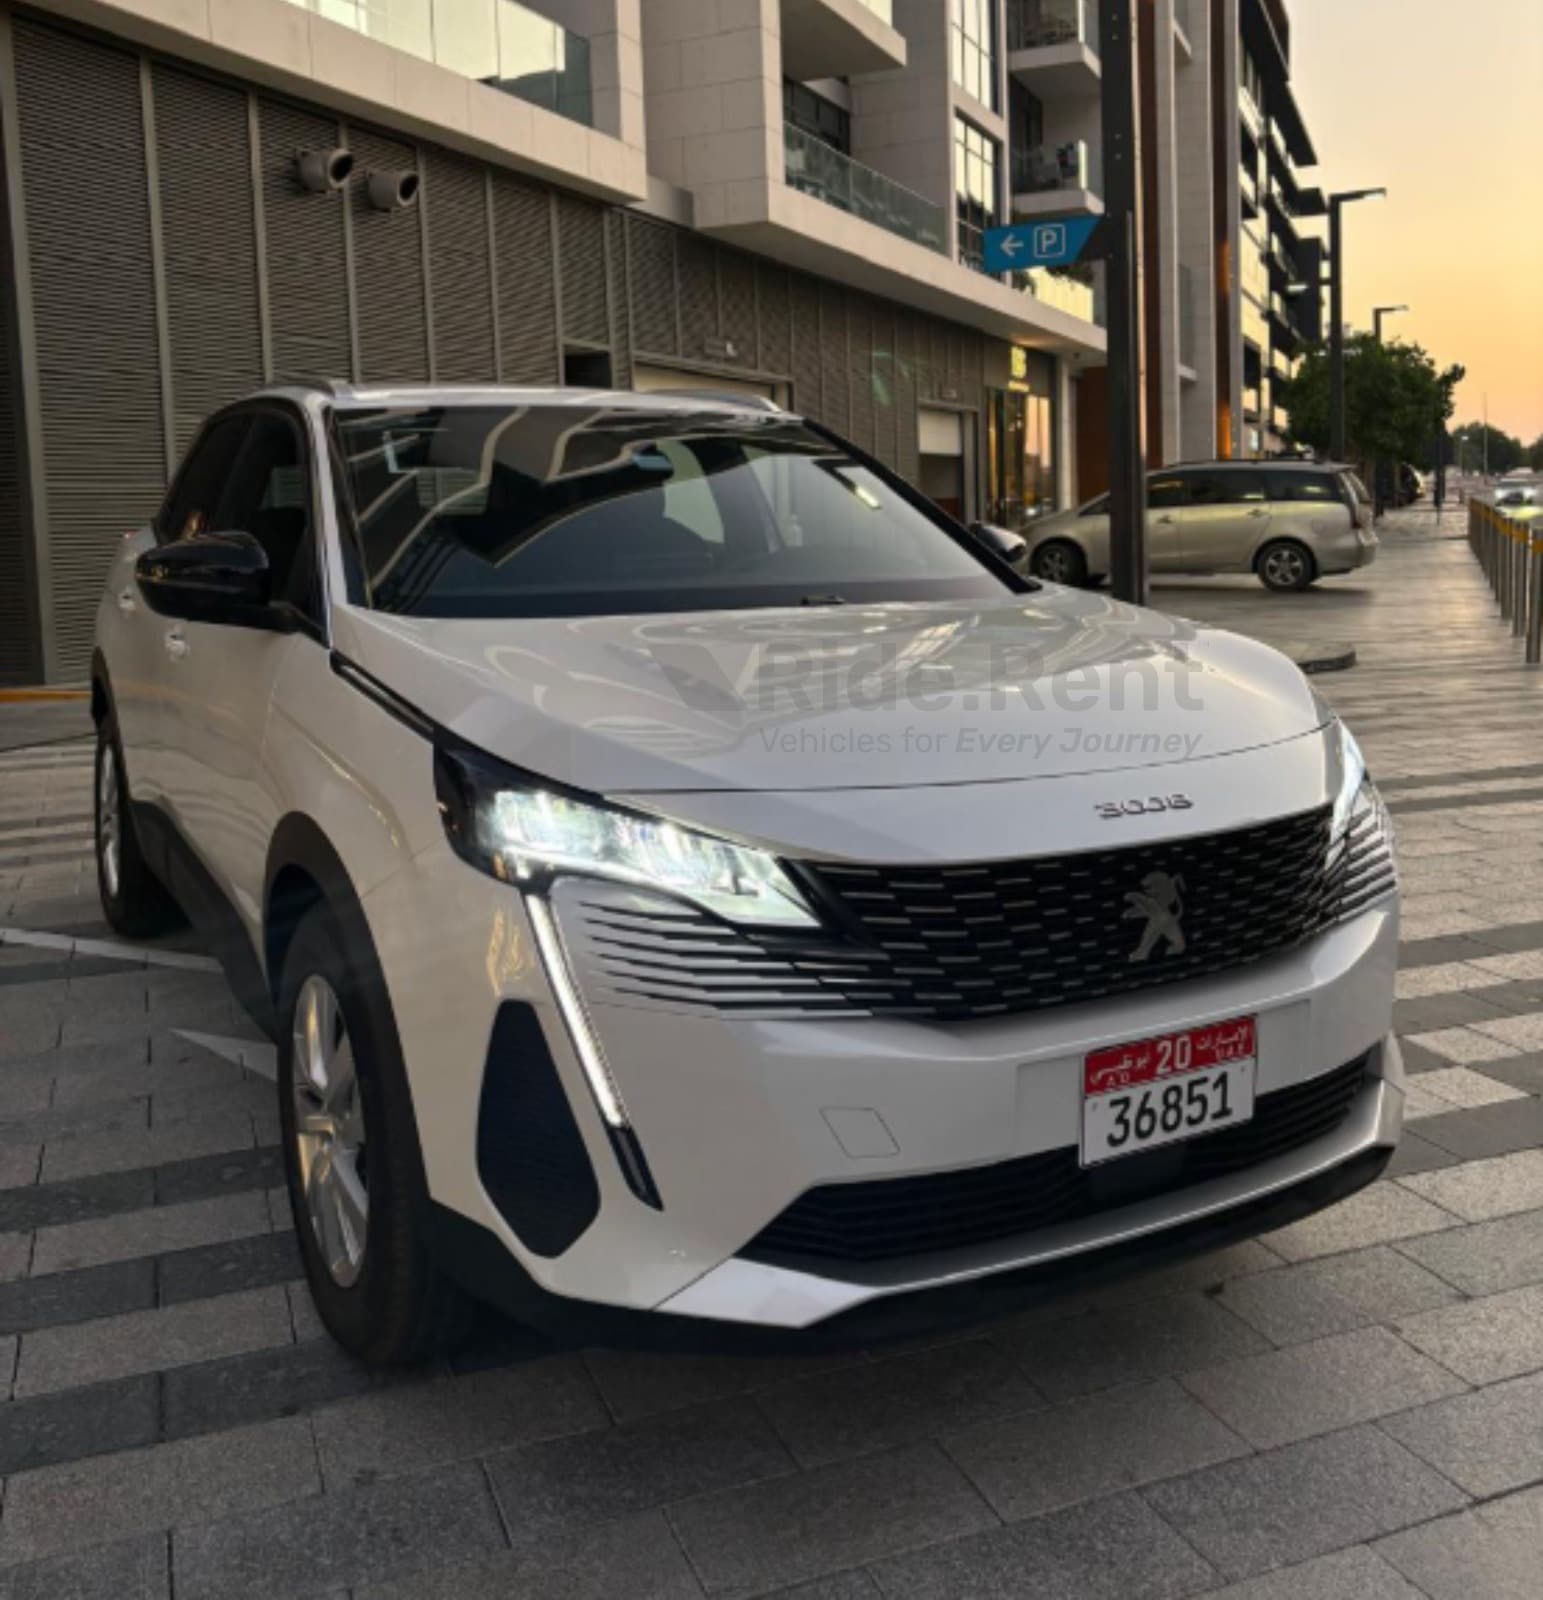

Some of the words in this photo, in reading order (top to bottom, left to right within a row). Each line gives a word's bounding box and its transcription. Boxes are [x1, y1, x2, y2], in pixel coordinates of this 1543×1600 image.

[1041, 228, 1057, 252] P
[1156, 1035, 1192, 1074] 20
[1106, 1071, 1232, 1147] 36851
